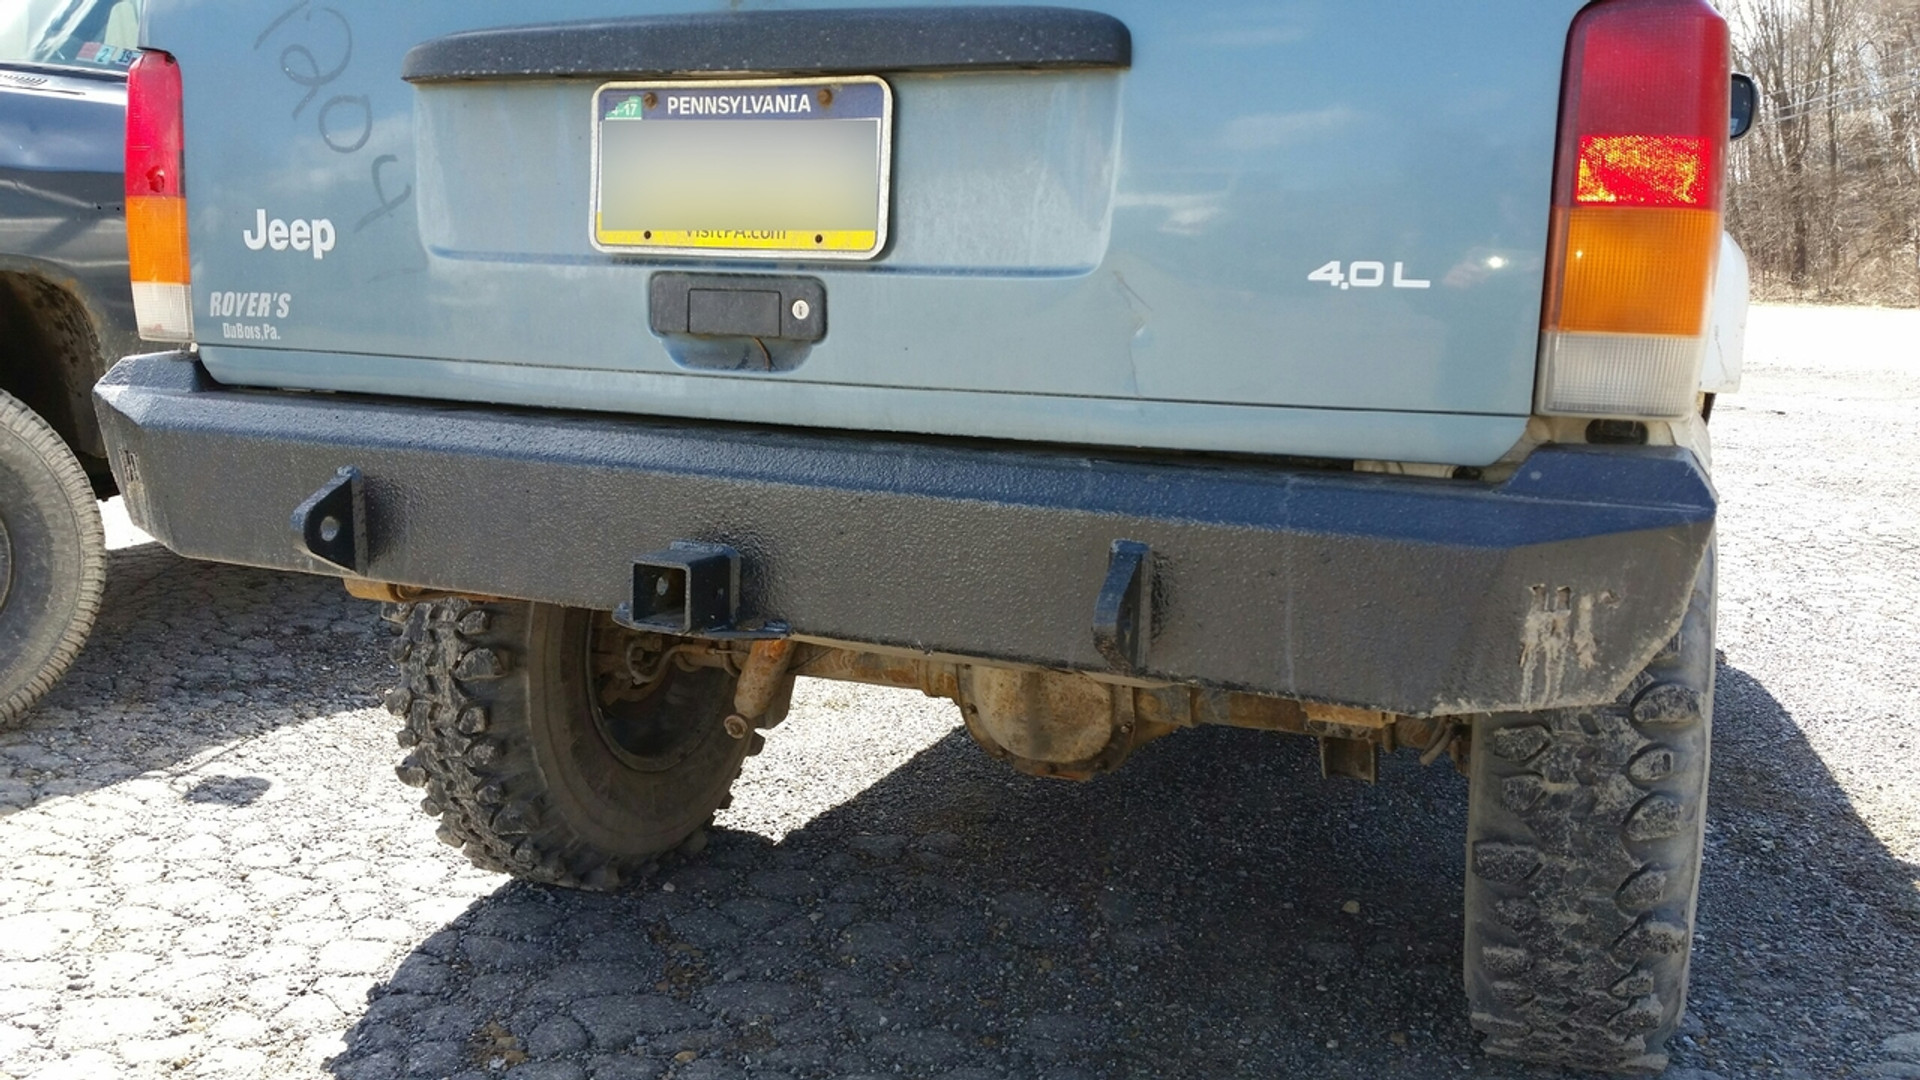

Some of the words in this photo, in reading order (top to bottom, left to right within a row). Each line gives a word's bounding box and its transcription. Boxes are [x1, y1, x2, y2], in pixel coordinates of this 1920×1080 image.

[667, 93, 812, 115] PENNSYLVANIA
[243, 208, 336, 259] Jeep
[209, 291, 292, 318] ROYER'S
